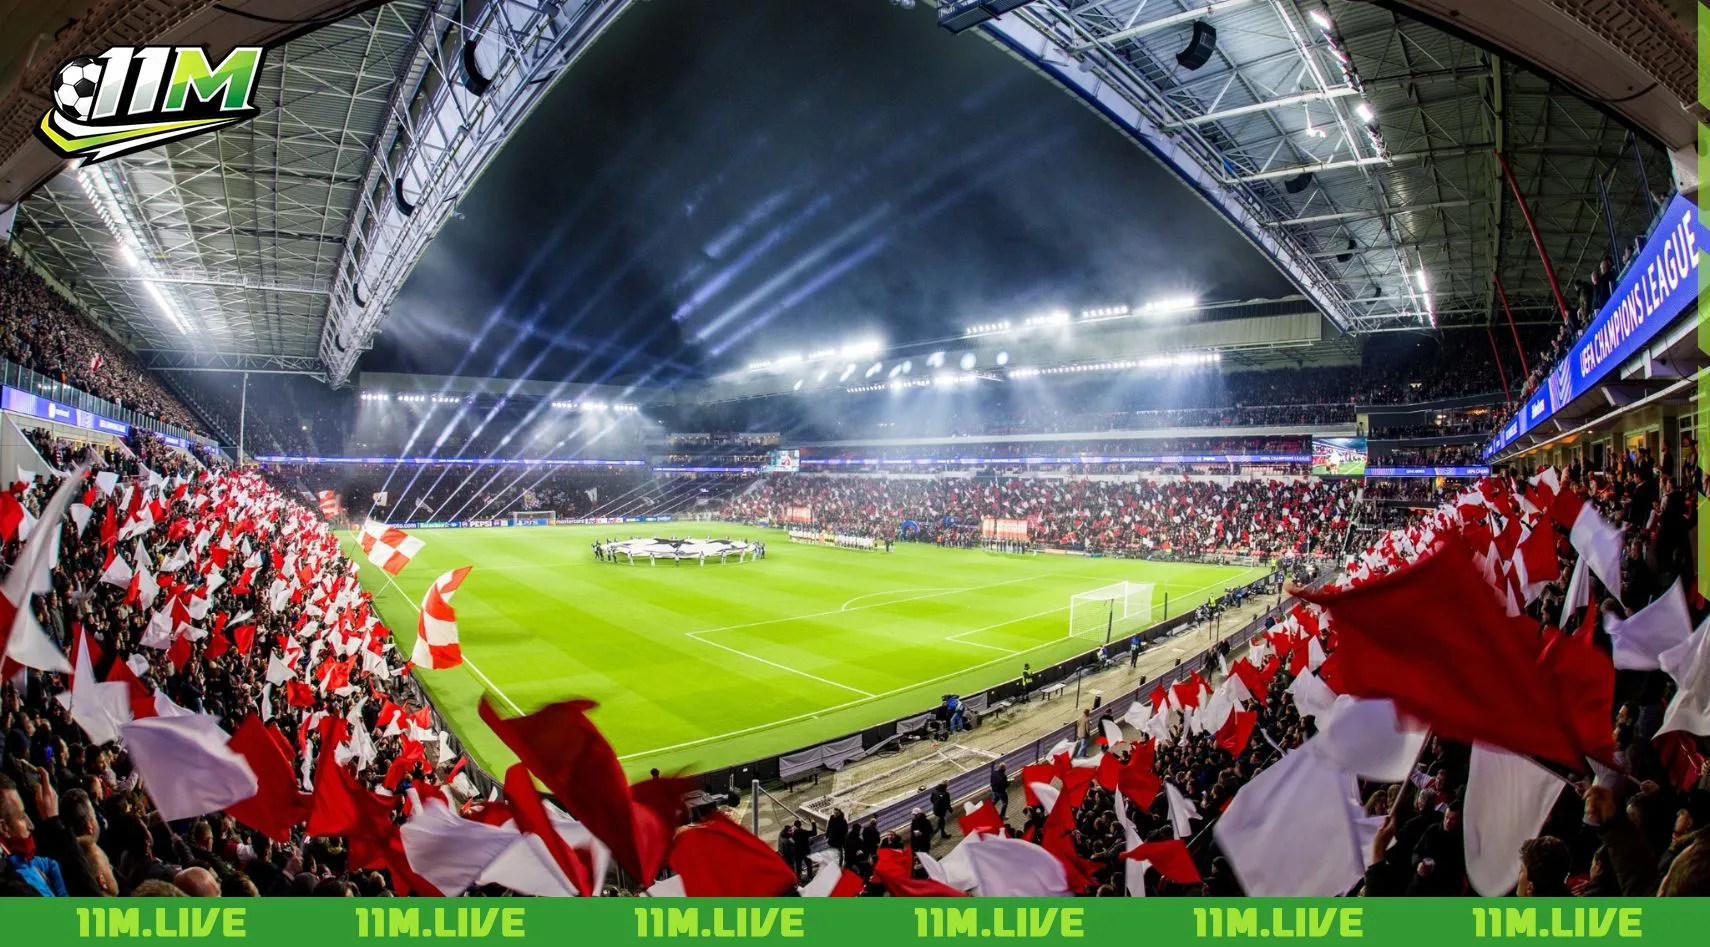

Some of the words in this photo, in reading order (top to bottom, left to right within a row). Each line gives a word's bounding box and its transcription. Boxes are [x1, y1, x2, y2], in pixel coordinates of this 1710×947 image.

[1580, 347, 1597, 378] UEFA
[1594, 281, 1645, 363] CHAMPIONS
[1642, 210, 1699, 317] LEAGUE
